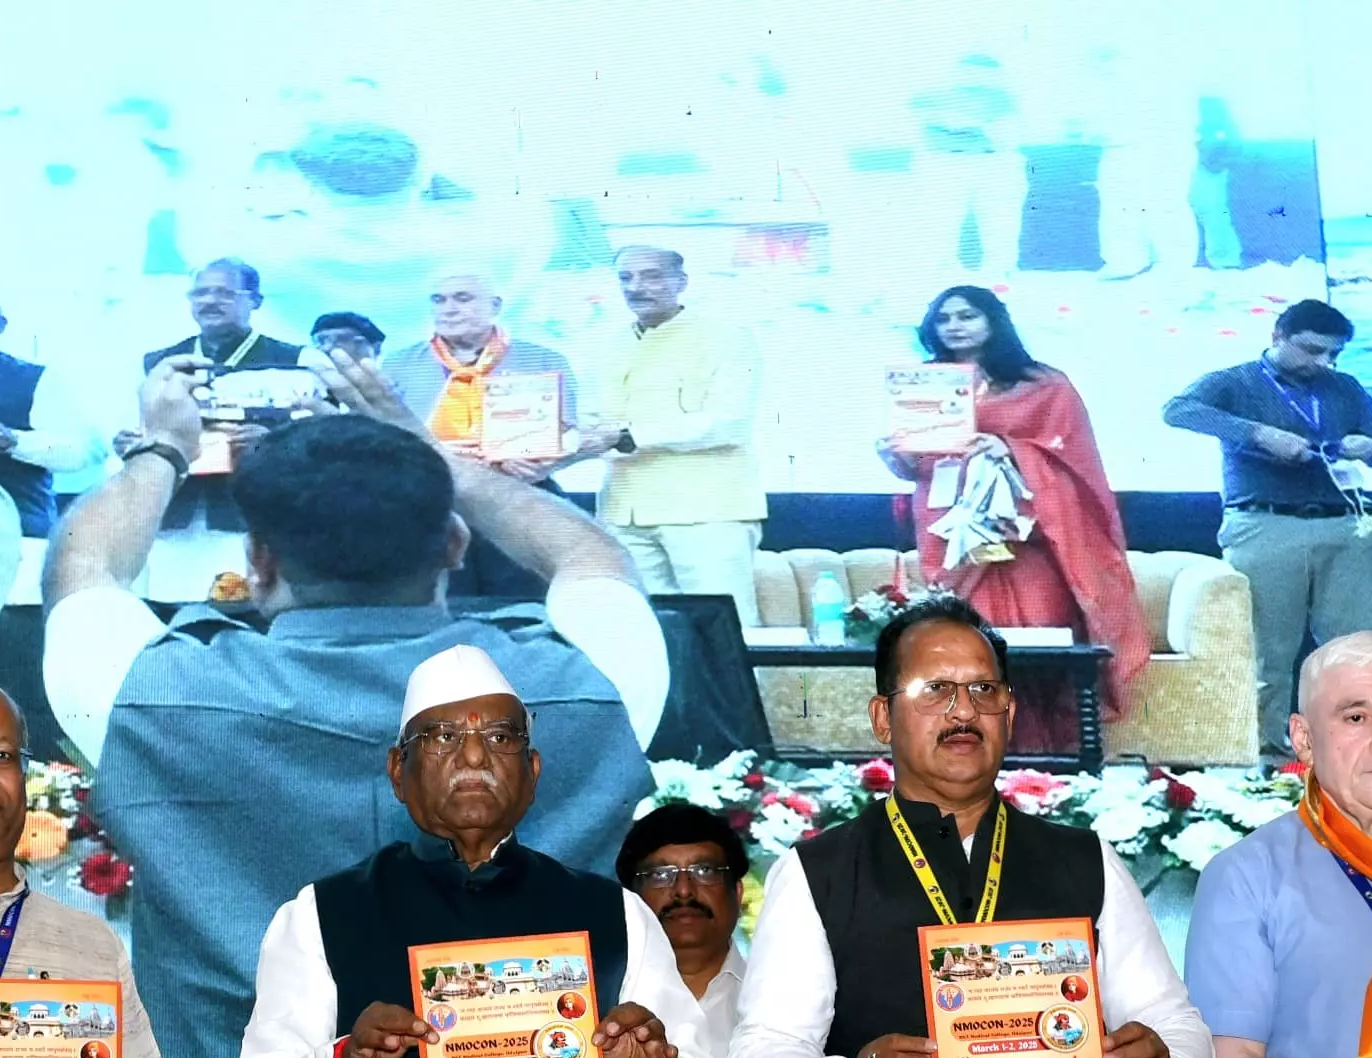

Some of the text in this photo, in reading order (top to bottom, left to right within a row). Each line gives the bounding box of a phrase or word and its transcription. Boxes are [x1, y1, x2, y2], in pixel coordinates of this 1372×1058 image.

[954, 1017, 1034, 1032] NMOCON-2025
[445, 1036, 528, 1052] NMOCON-2025
[971, 1043, 999, 1053] March
[1018, 1041, 1038, 1050] 2025
